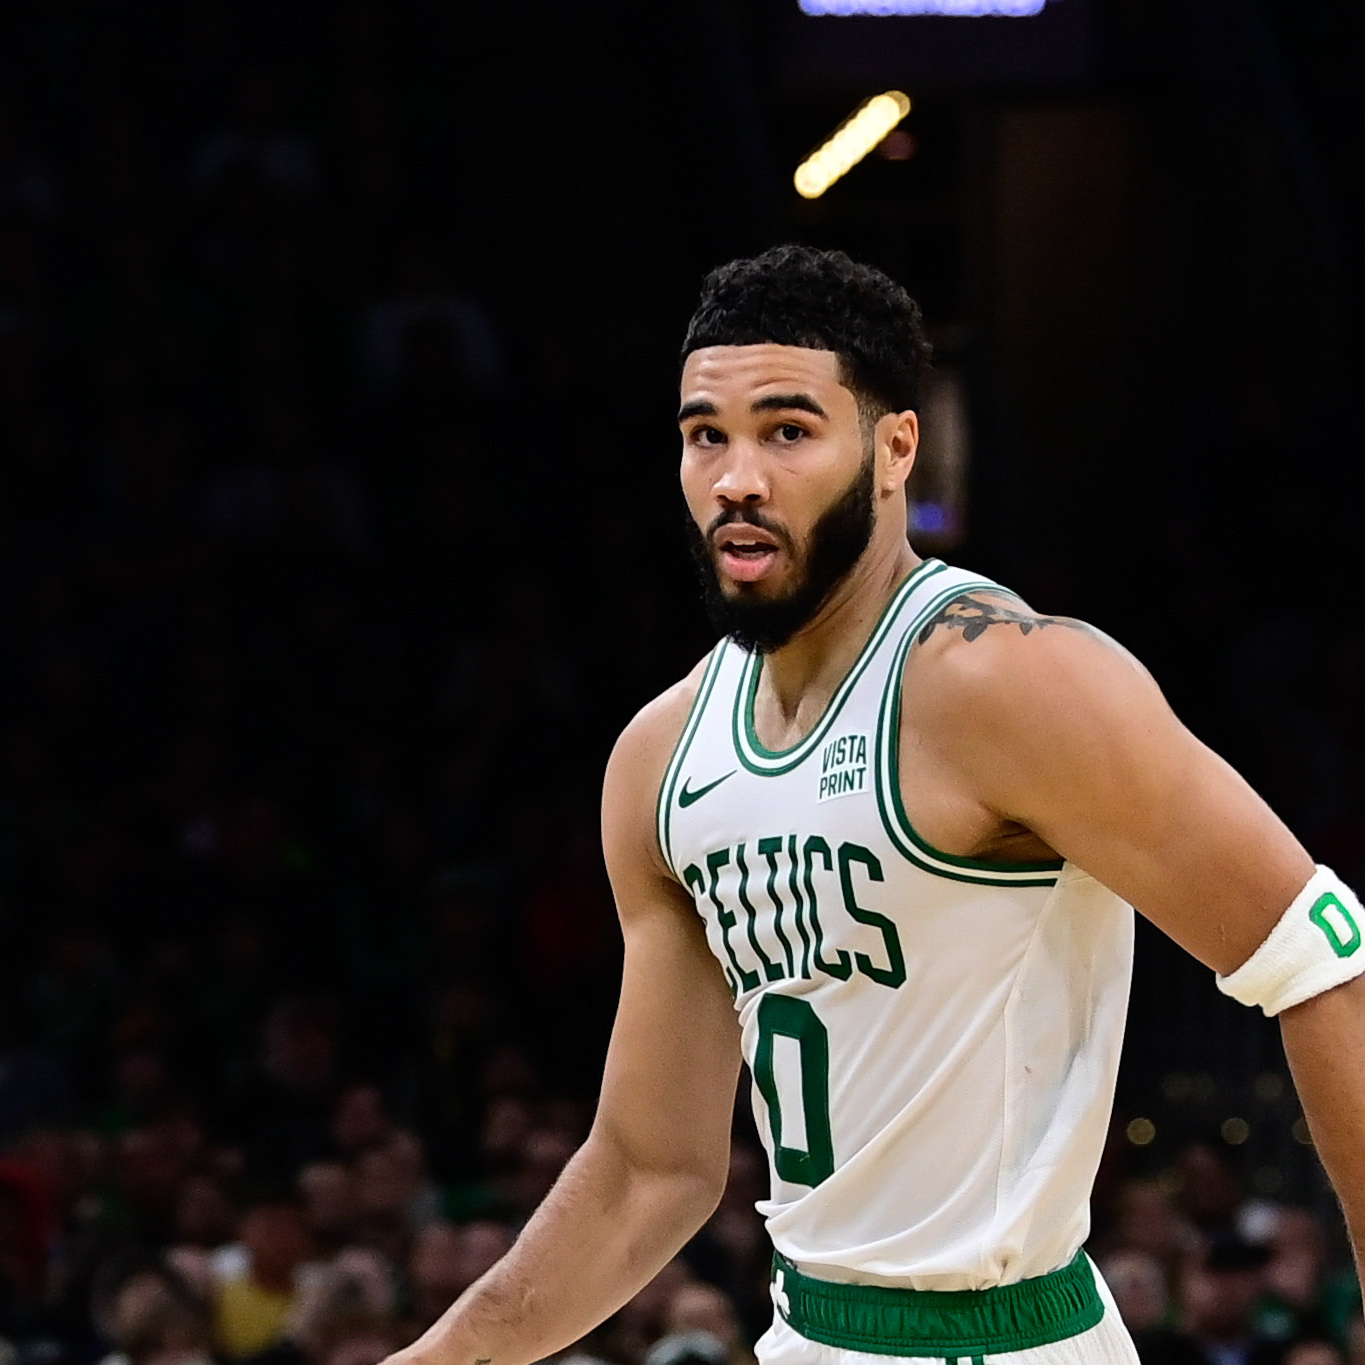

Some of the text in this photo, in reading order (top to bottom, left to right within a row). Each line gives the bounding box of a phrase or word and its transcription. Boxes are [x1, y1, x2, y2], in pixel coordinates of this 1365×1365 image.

[819, 767, 867, 800] PRINT
[822, 734, 867, 774] VISTA
[683, 834, 907, 1000] CELTICS
[1307, 891, 1361, 958] 0
[754, 992, 835, 1190] 0
